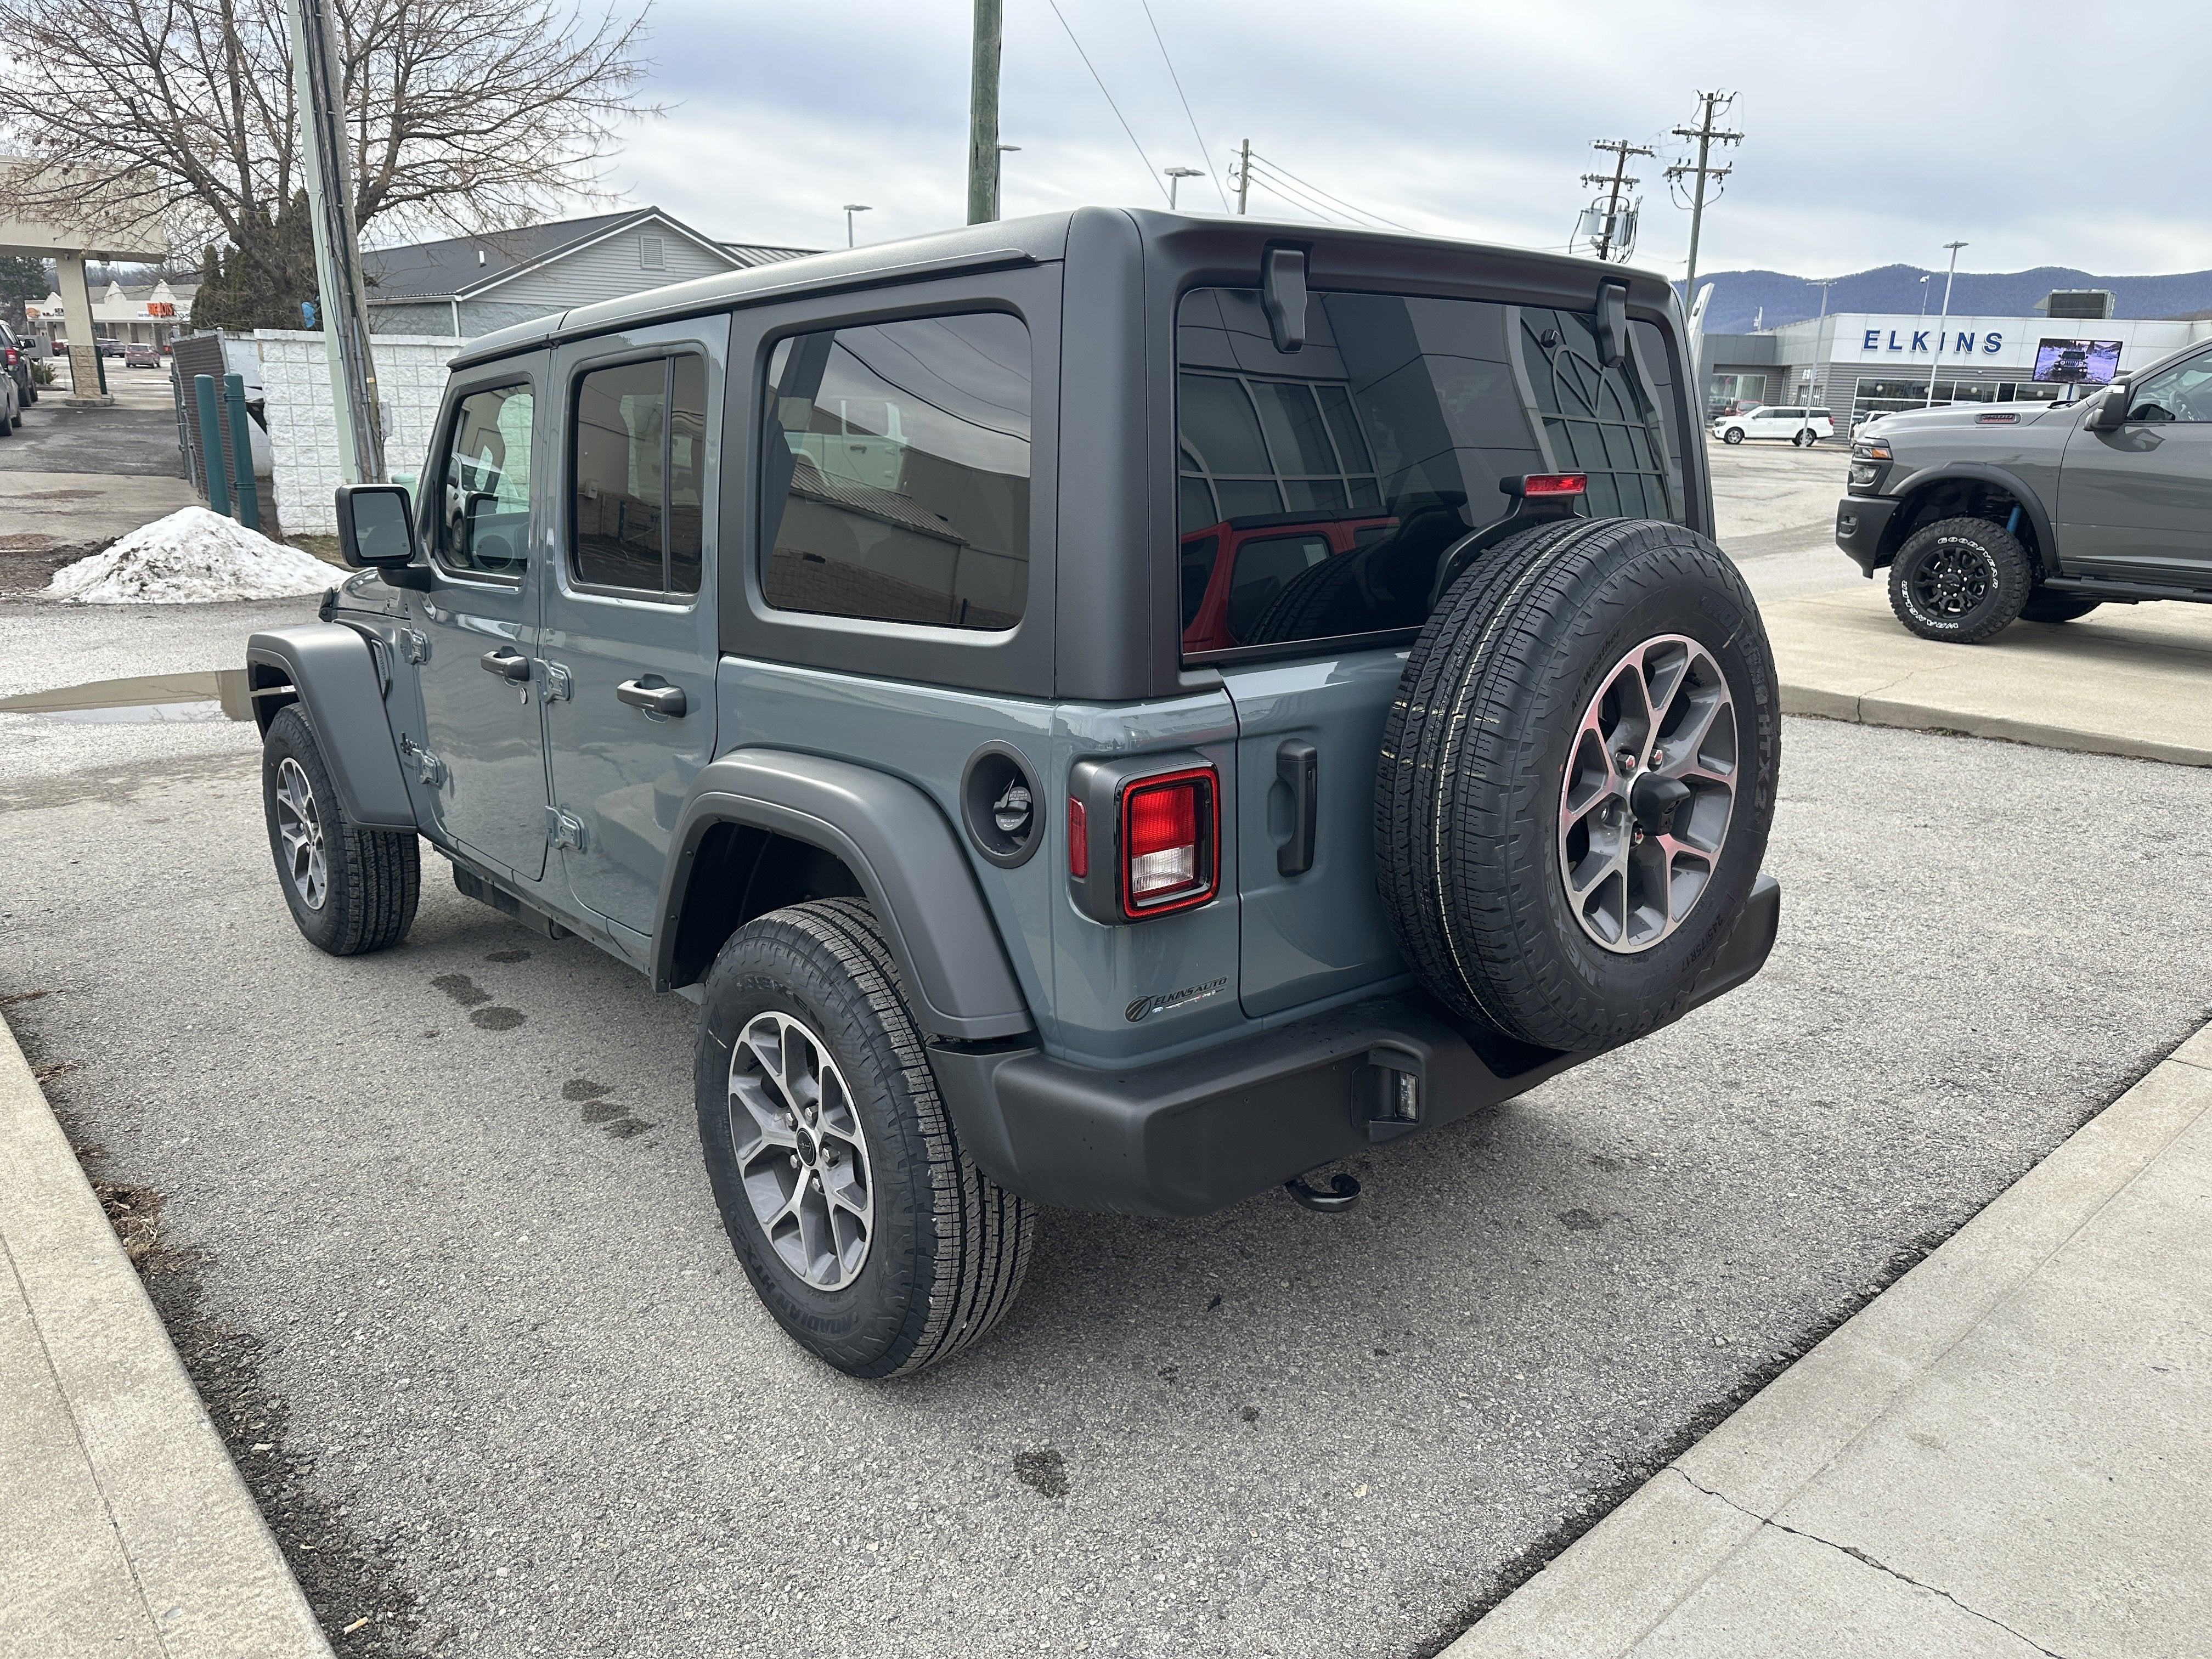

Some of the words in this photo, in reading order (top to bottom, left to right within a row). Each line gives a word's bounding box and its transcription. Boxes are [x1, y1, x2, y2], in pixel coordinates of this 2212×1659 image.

[1862, 329, 2003, 354] ELKINS
[1937, 537, 1999, 589] GOODYEAR
[1901, 579, 1959, 629] WRANGLER
[1544, 838, 1596, 986] NEXEN
[1154, 987, 1195, 1006] ELKINS
[1194, 977, 1228, 994] AUTO
